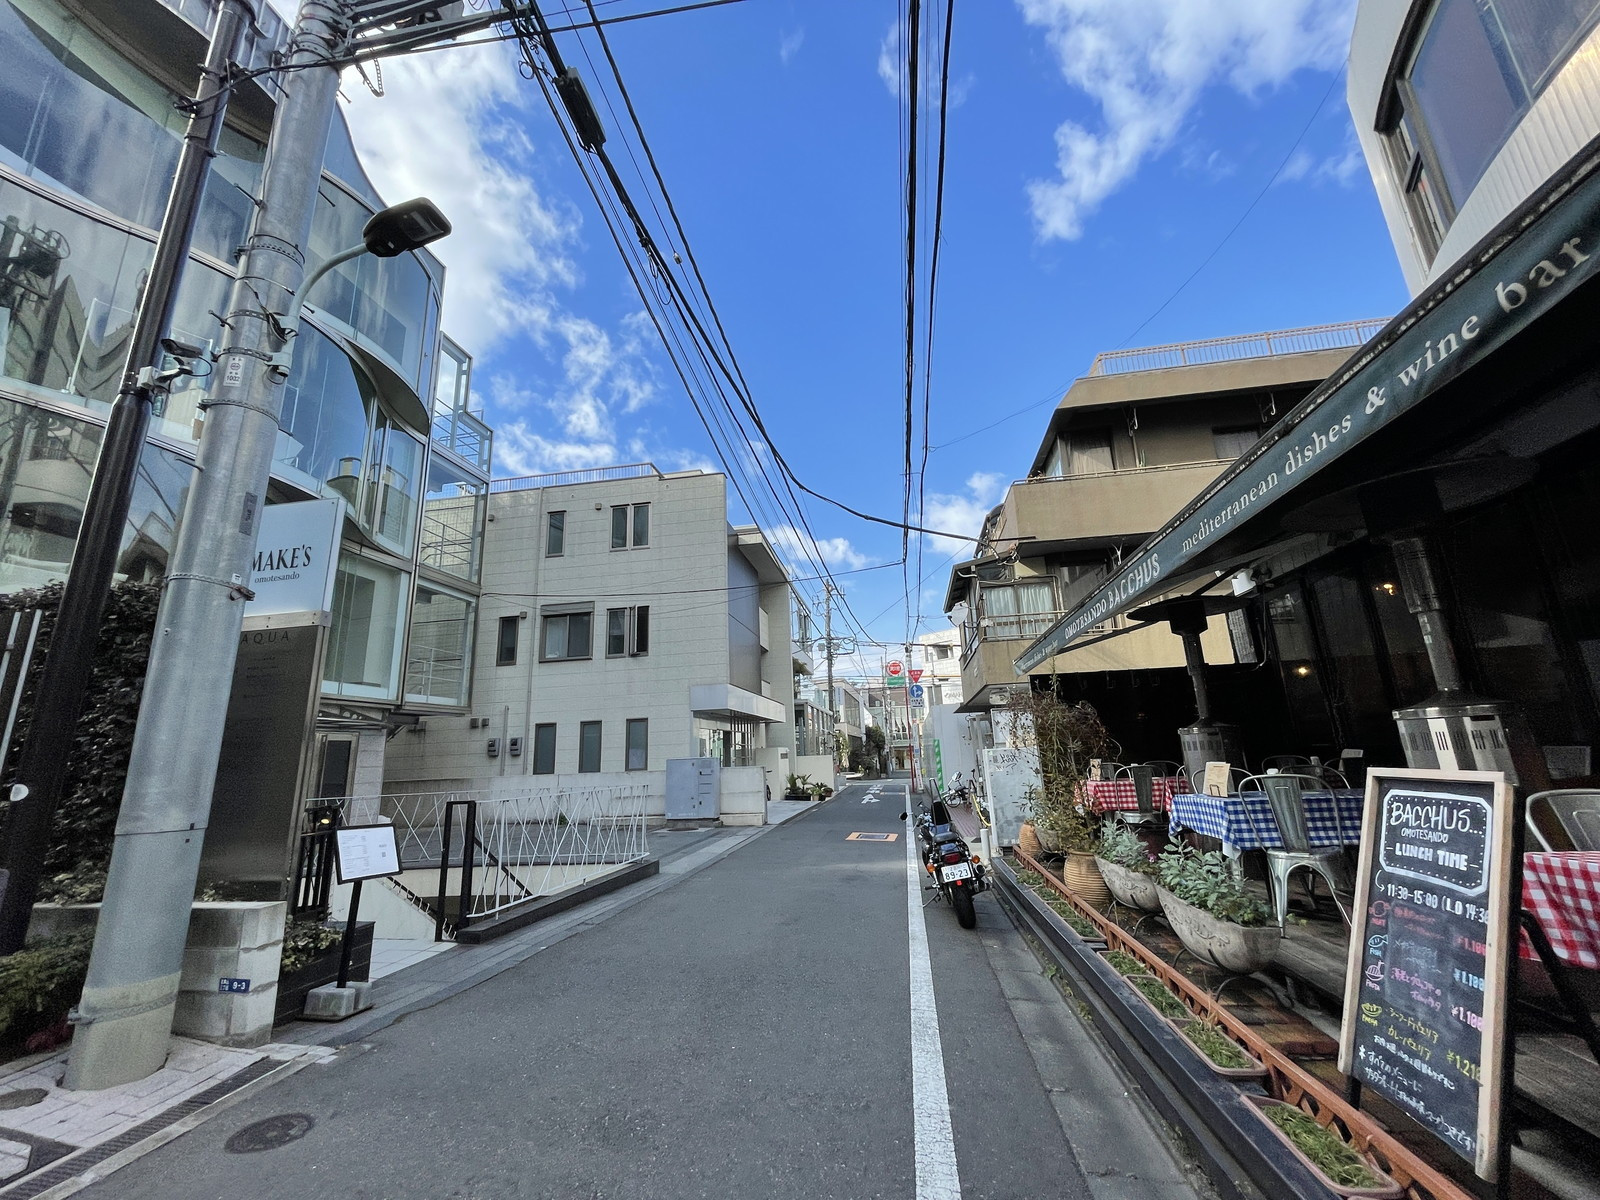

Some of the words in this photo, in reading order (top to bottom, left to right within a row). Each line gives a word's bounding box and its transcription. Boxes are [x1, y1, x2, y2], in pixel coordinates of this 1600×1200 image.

[1065, 599, 1106, 639] OMOTESANDO
[1107, 553, 1160, 609] BACCHUS
[1182, 472, 1279, 553] mediterranean
[1284, 413, 1352, 477] dishes
[1364, 386, 1387, 416] &
[1397, 315, 1481, 388] wine
[1494, 236, 1591, 313] bar
[254, 571, 300, 583] omotesando
[1401, 827, 1449, 843] OMOTESANDO
[1394, 842, 1434, 862] LUNCH
[1436, 849, 1468, 871] TIME
[232, 981, 246, 990] 9-3
